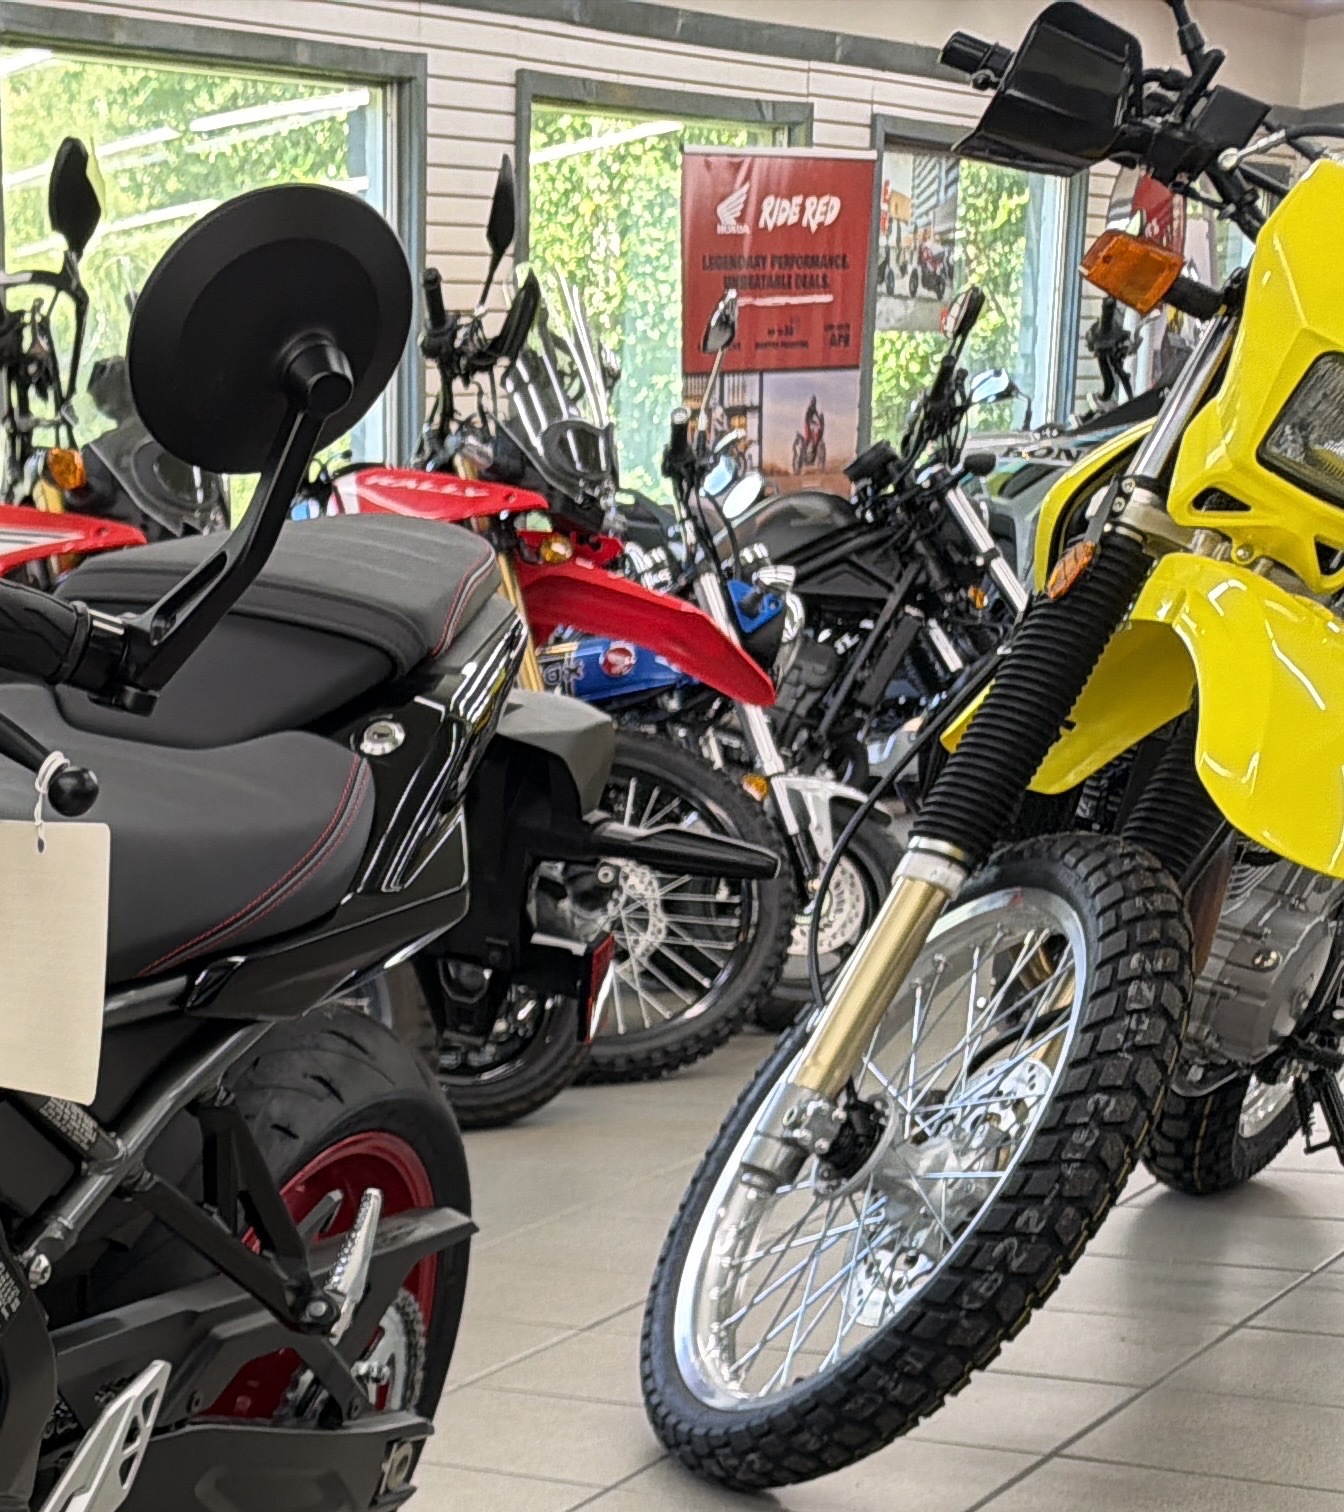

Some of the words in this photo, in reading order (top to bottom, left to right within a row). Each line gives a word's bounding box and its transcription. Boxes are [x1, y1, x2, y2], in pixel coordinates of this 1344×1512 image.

[758, 194, 803, 232] RIDE
[802, 194, 841, 234] RED
[702, 254, 768, 271] LEGENDARY
[724, 275, 793, 290] UNBEATABLE
